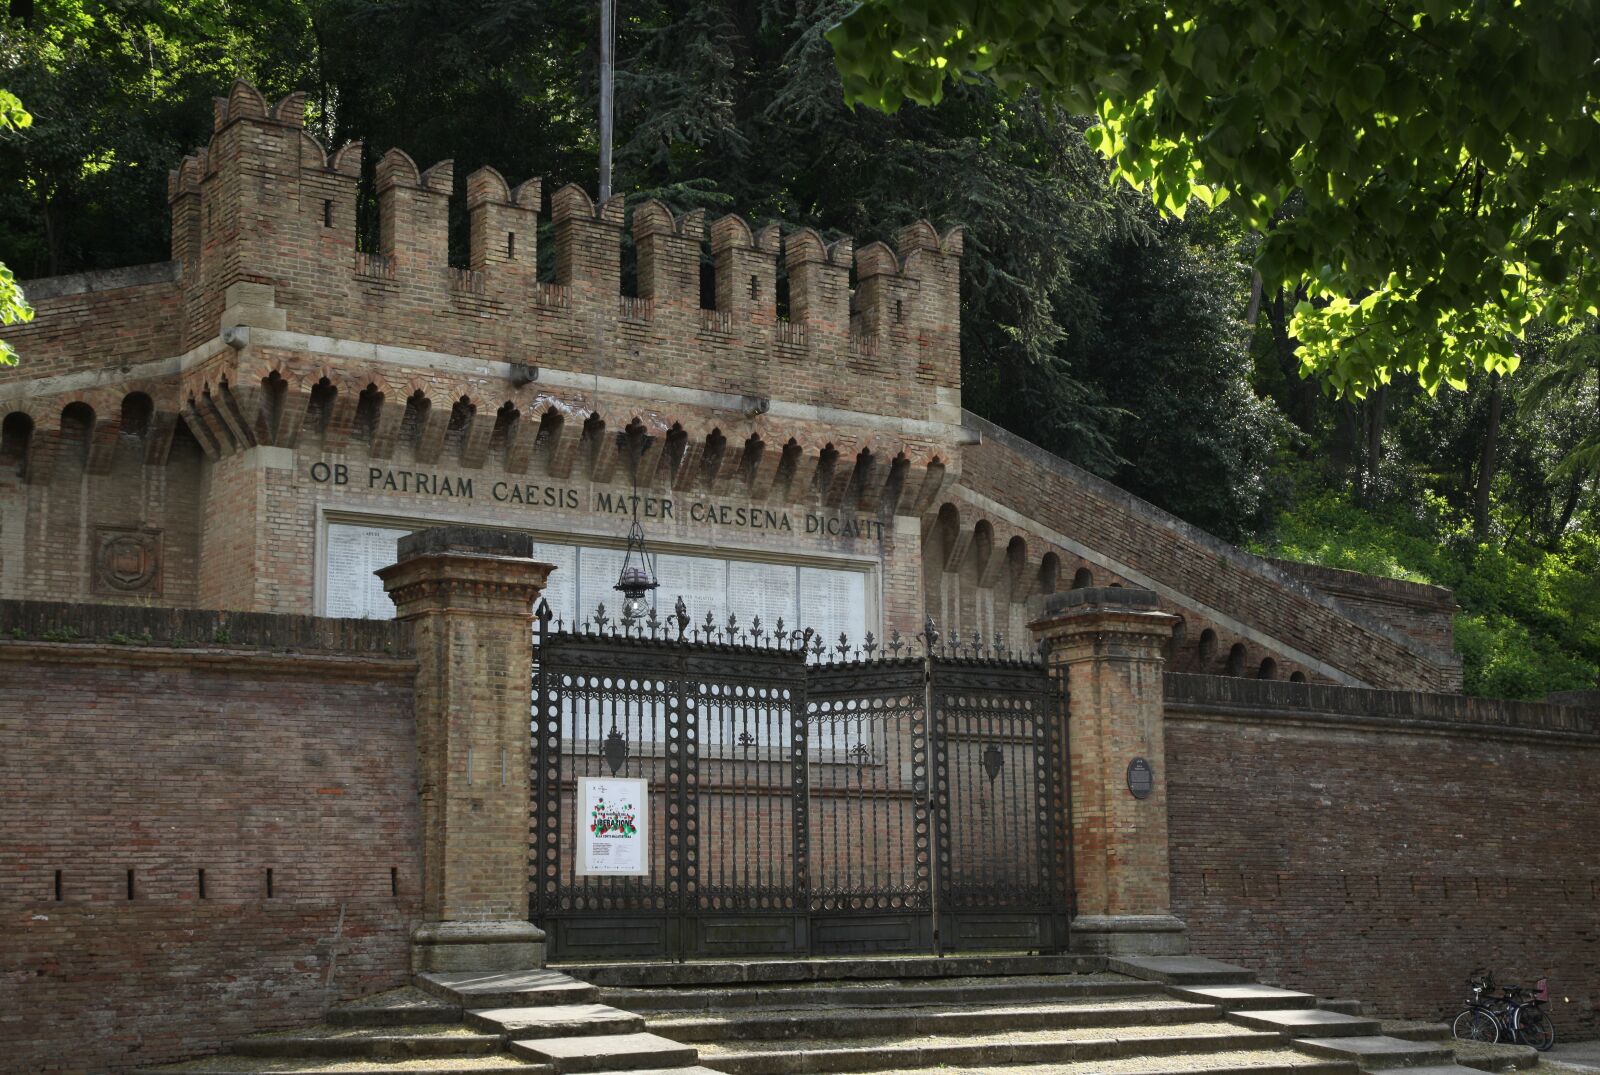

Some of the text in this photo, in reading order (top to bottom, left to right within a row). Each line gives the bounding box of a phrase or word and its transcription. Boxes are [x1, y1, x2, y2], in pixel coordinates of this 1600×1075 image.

[310, 462, 885, 541] OB PATRIAM CAESIS MATER CAESENA DICAVIT
